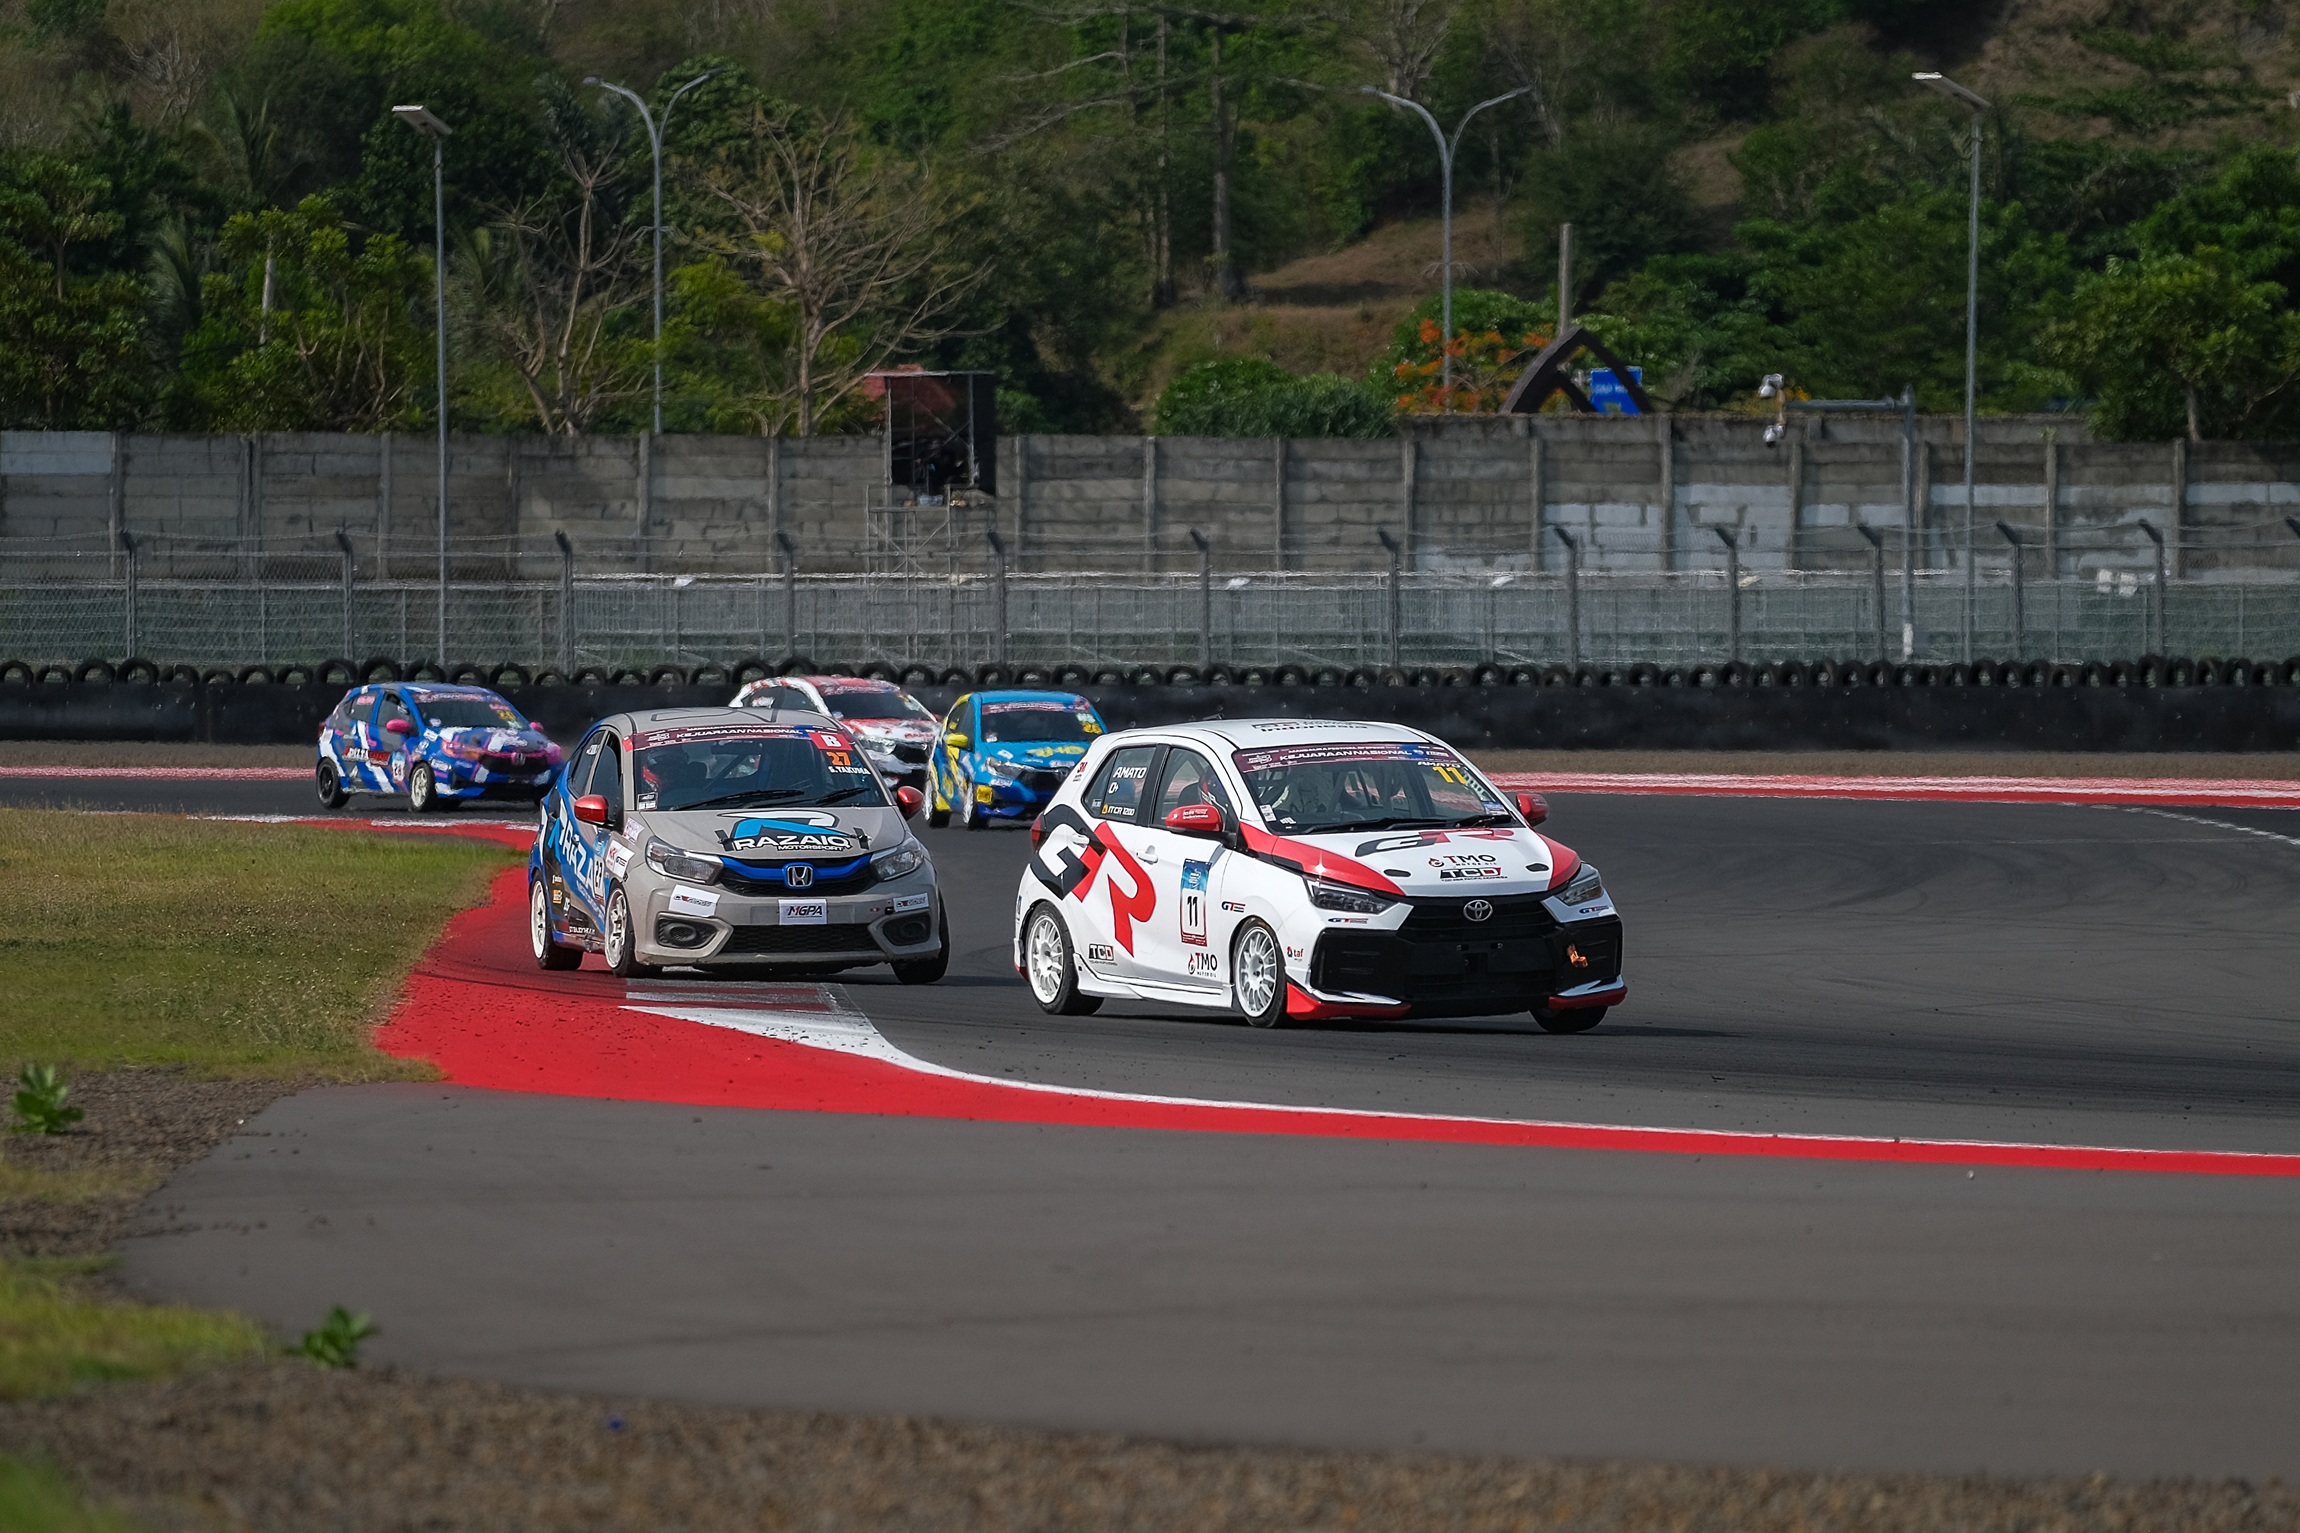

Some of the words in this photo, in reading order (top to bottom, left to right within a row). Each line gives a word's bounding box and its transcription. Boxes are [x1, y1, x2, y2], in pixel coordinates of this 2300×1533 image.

[676, 729, 746, 739] KEJUARAAN
[820, 734, 842, 748] B
[826, 751, 852, 766] 27
[1279, 750, 1354, 761] KEJUARAAN
[1112, 766, 1148, 779] AMATO
[1432, 766, 1467, 785] 11
[733, 834, 852, 851] RAZAIQ
[1443, 854, 1497, 864] TMO
[1442, 867, 1499, 878] TCD
[787, 905, 823, 916] MGPA
[1186, 895, 1199, 928] 11
[1089, 944, 1114, 960] TCD
[1195, 952, 1219, 972] TMO
